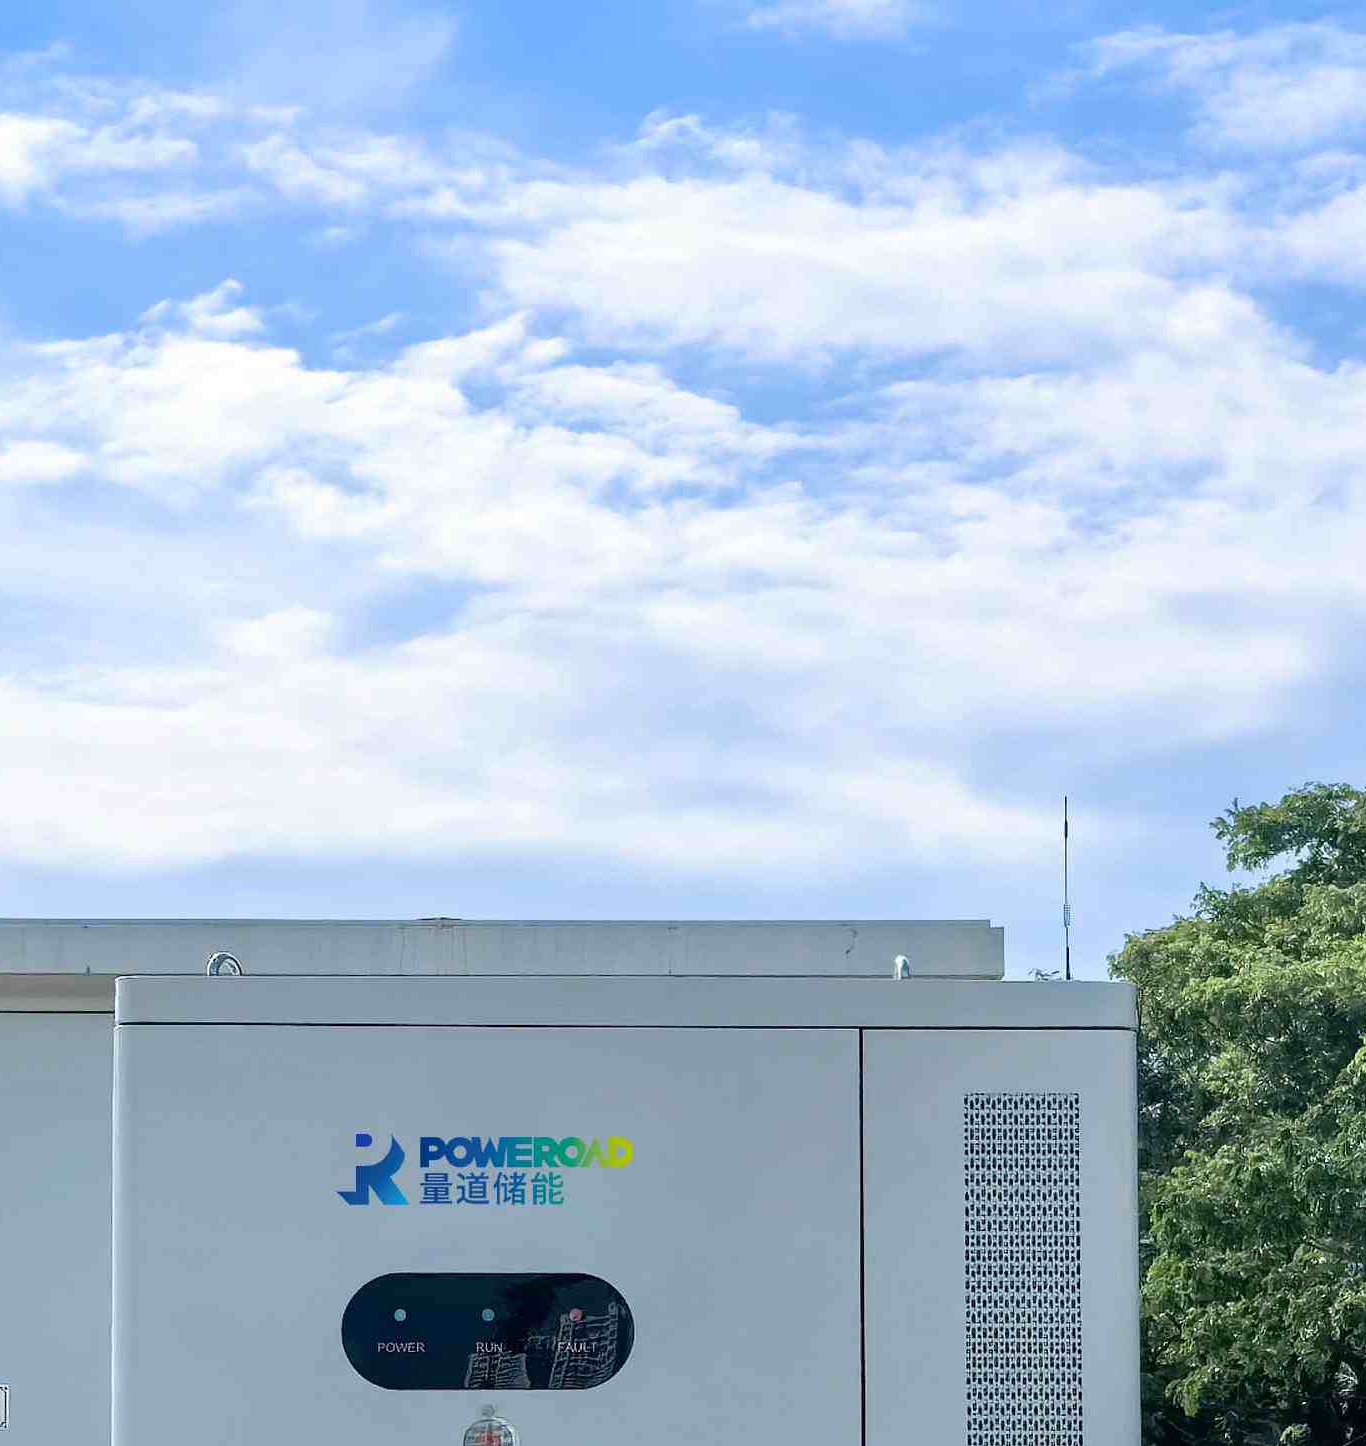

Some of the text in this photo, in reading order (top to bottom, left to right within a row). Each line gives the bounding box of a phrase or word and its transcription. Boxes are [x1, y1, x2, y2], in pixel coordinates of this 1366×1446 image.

[419, 1136, 634, 1168] POWEROAD
[419, 1172, 565, 1206] 量道储能
[377, 1342, 426, 1353] POWER
[476, 1342, 503, 1353] RUN
[557, 1341, 598, 1353] FAULT
